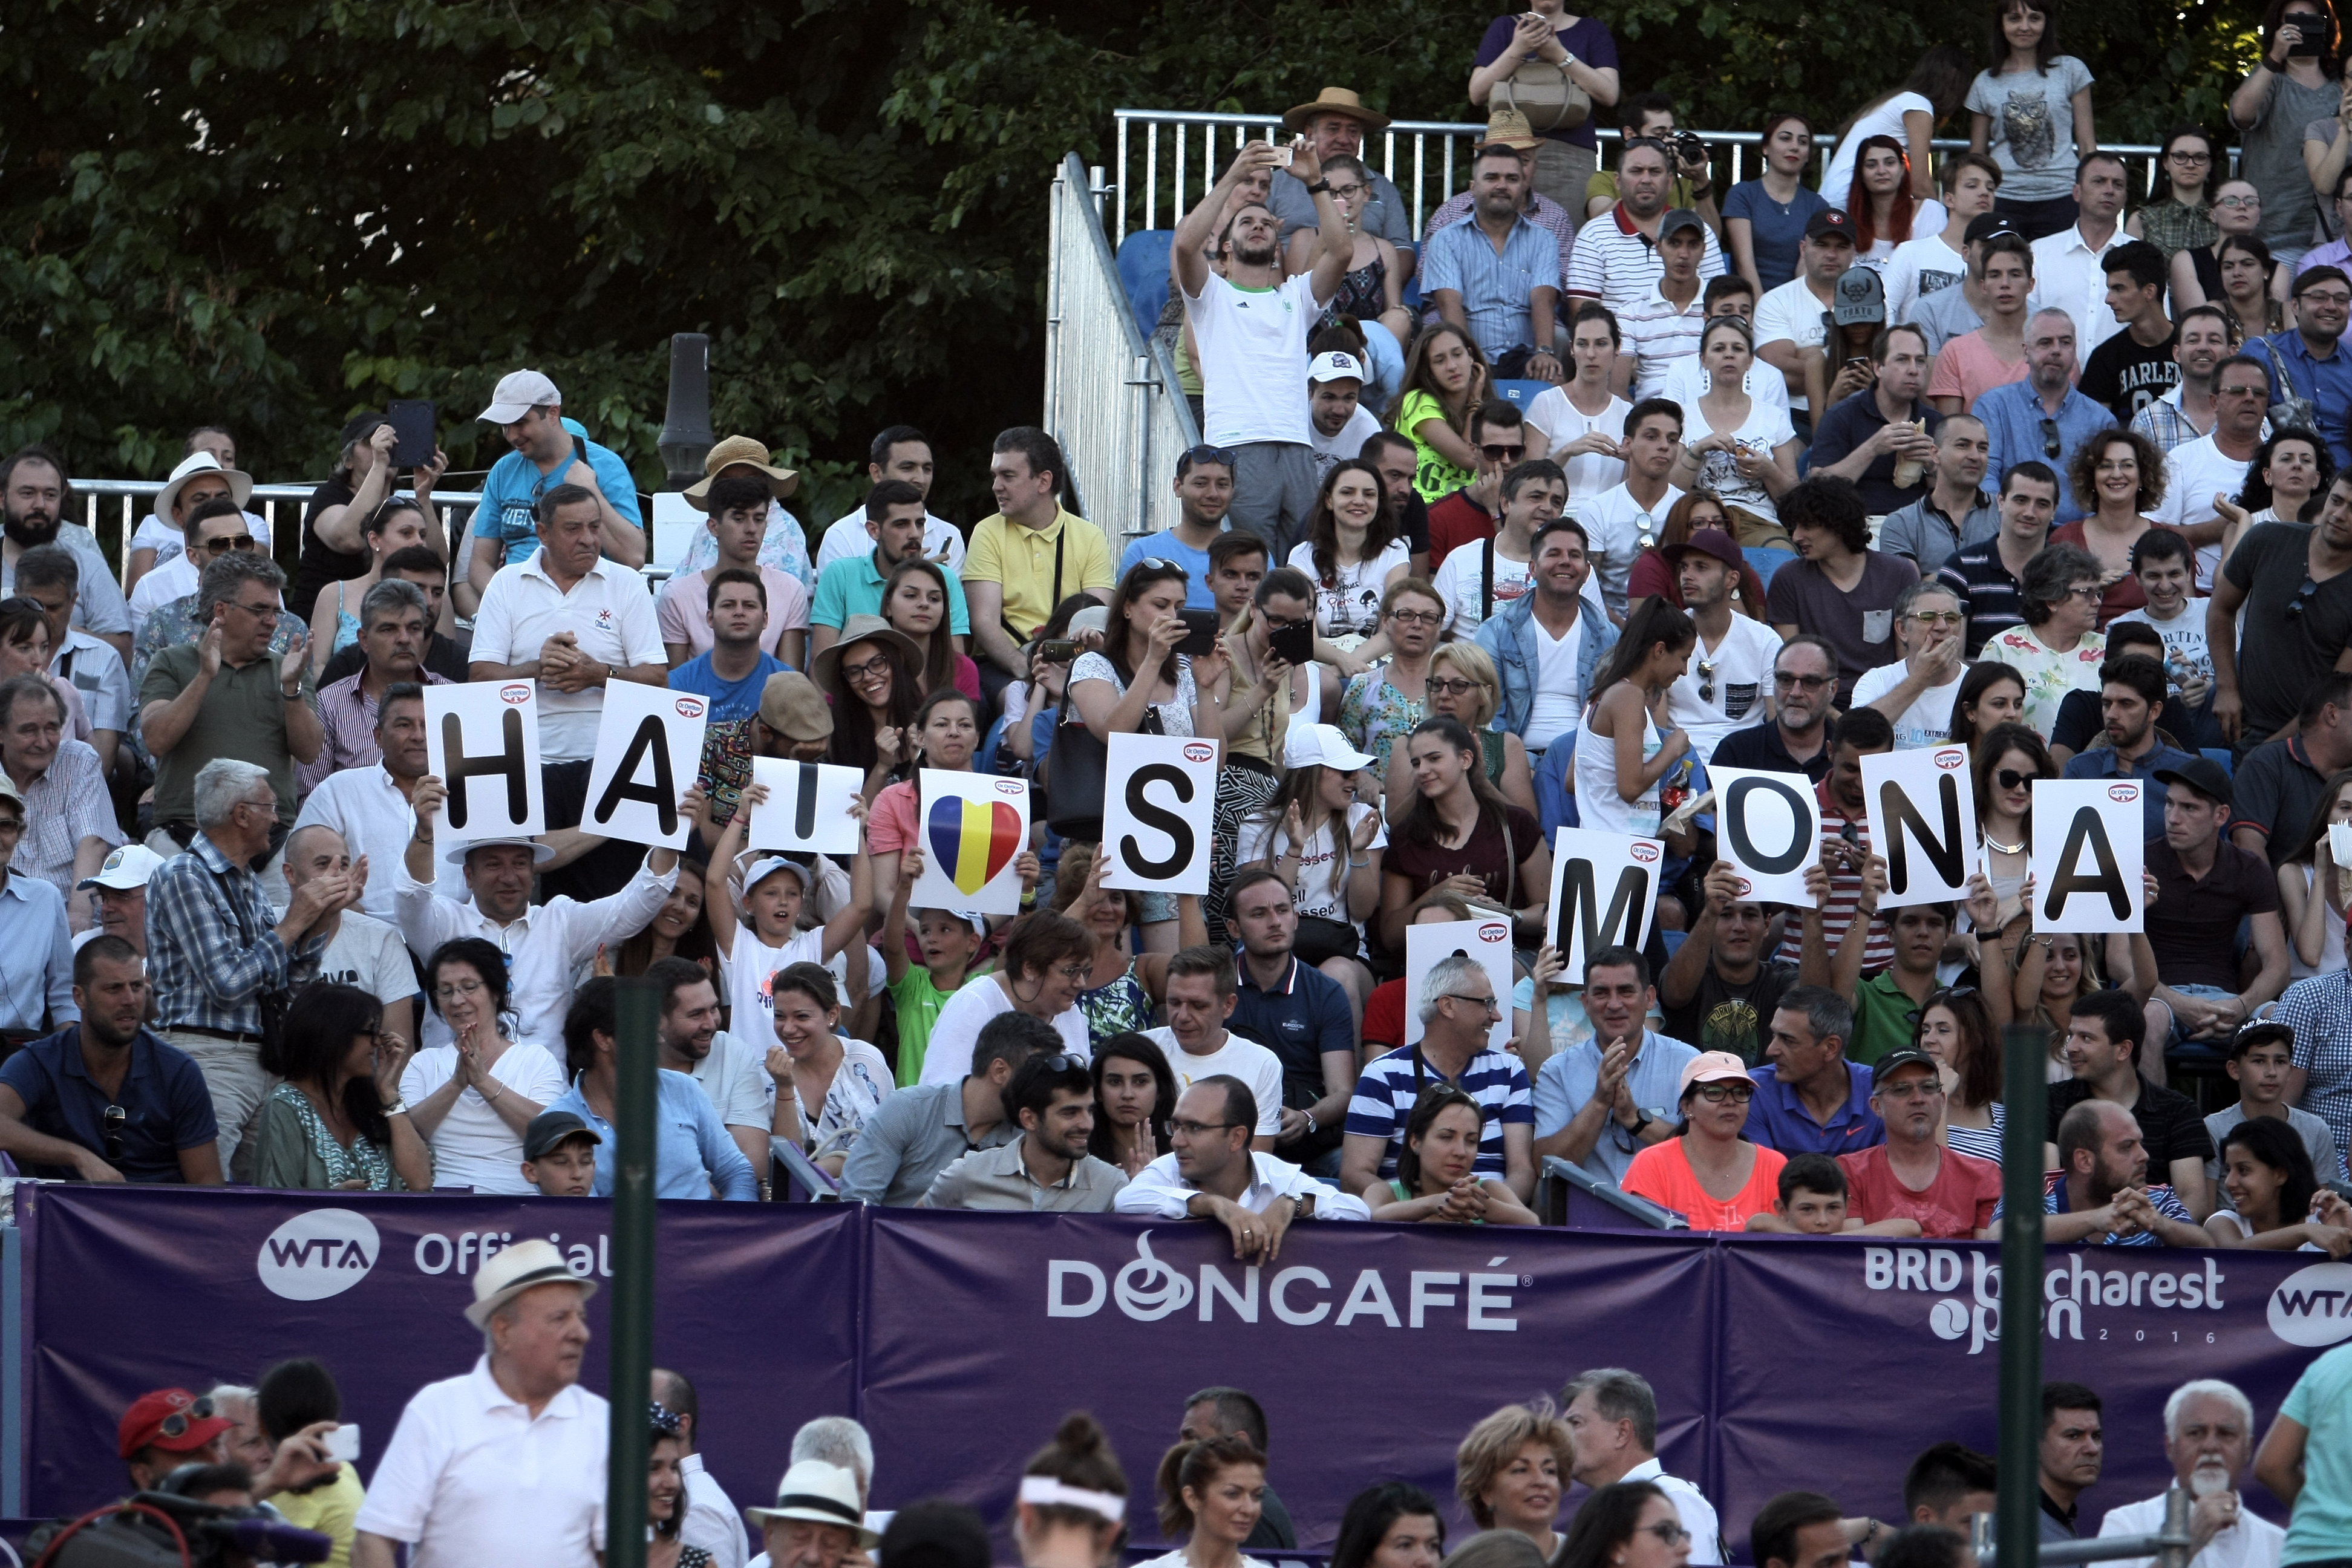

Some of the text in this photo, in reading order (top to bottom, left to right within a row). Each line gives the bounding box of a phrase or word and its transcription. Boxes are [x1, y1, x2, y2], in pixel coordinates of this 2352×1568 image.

[442, 708, 528, 829] H
[595, 715, 678, 835] A
[1924, 730, 1952, 738] EXTREM
[1120, 763, 1194, 880] S
[1726, 777, 1812, 875] O
[1880, 774, 1964, 895] N
[2044, 806, 2131, 921] A
[1556, 857, 1650, 971] M
[268, 1238, 370, 1269] WTA
[415, 1232, 612, 1277] Offal
[1048, 1257, 1518, 1331] DONCAFÉ
[1864, 1247, 2224, 1308] BRD bcharest
[1930, 1299, 2085, 1354] opn
